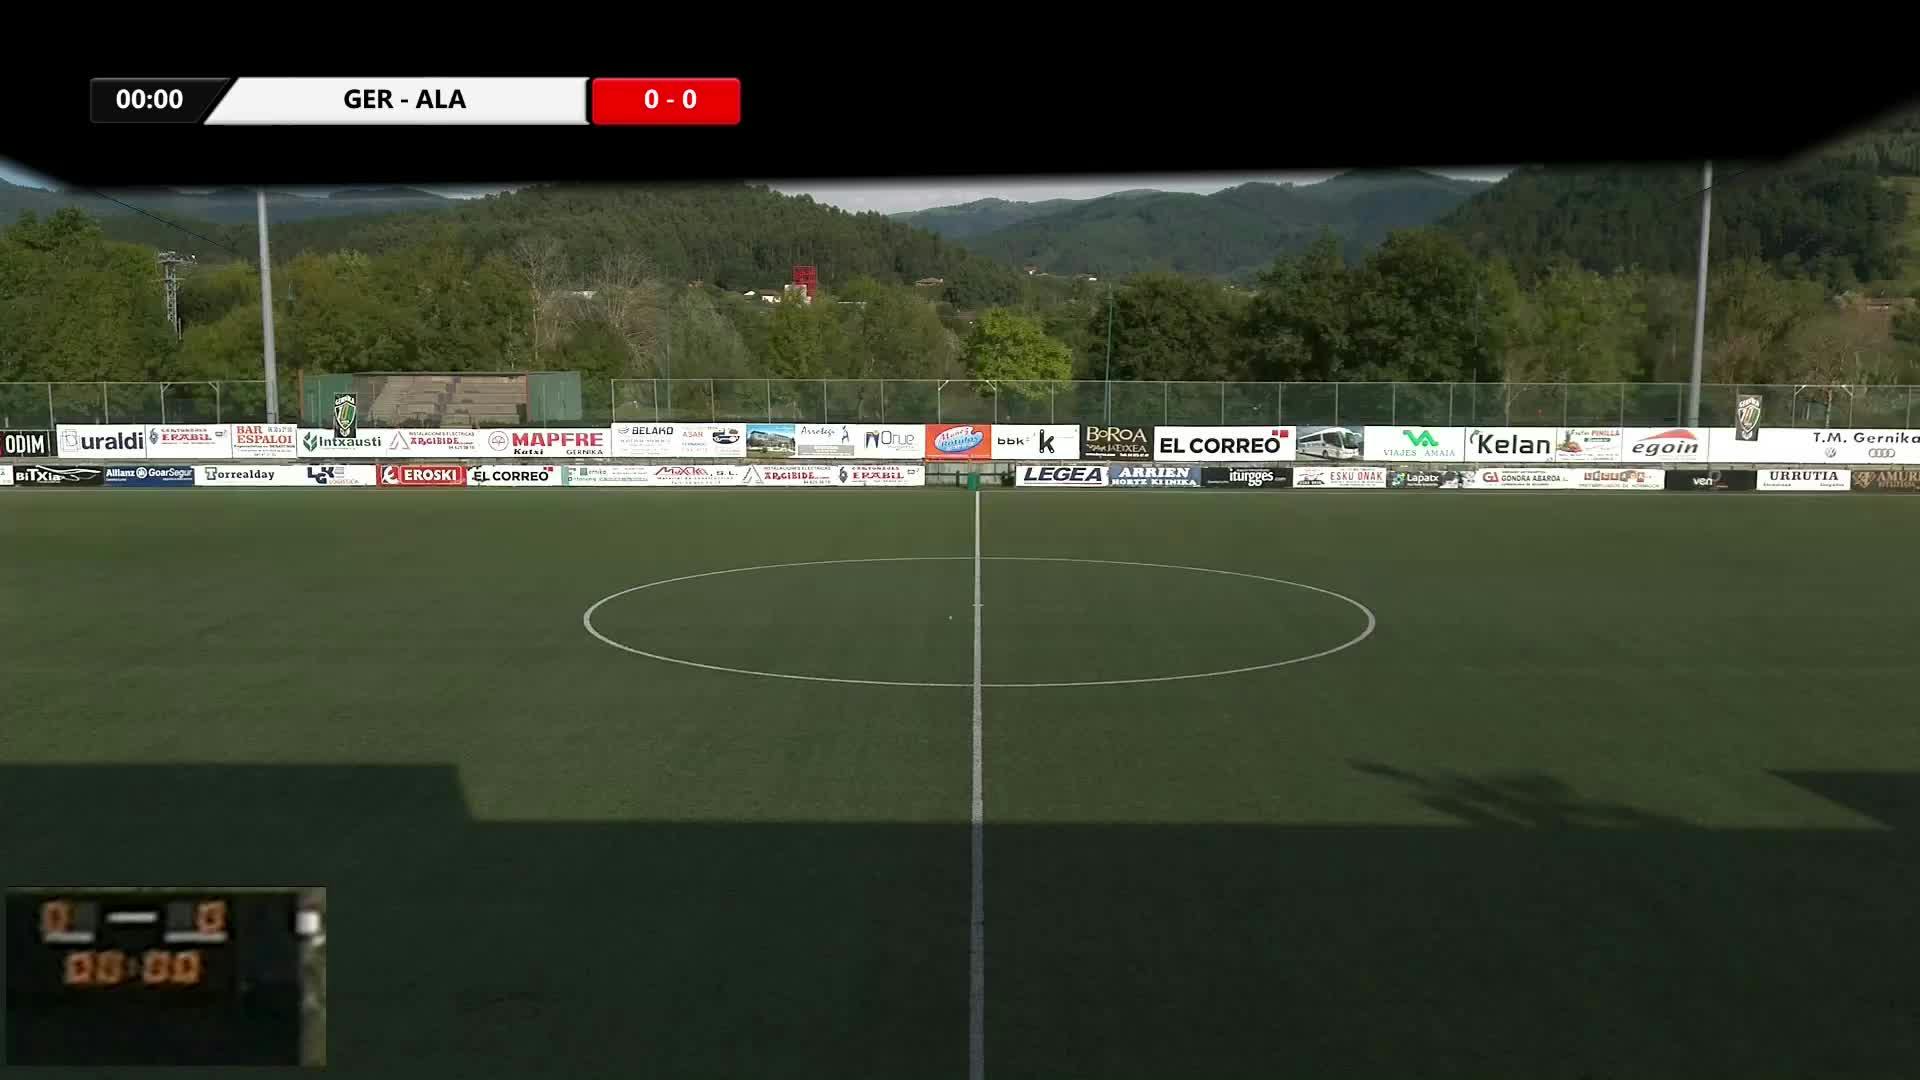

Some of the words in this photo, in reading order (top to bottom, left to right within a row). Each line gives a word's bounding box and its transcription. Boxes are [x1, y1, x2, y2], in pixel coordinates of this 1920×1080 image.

[237, 426, 263, 434] BAR
[632, 426, 674, 435] BELAKO
[82, 432, 143, 450] uraldi
[237, 435, 293, 444] ESPALOI
[320, 436, 381, 447] Intxausti
[512, 432, 603, 447] MAPFRE
[997, 437, 1025, 446] bbk
[1813, 432, 1847, 443] T.M.
[1854, 432, 1920, 443] Gernika
[6, 434, 45, 454] ODIM
[1160, 437, 1186, 454] EL
[1189, 437, 1281, 454] CORREO
[1478, 434, 1551, 454] Kelan
[1632, 440, 1699, 457] egoin
[1384, 449, 1417, 457] VIAJES
[1425, 449, 1456, 457] AMAIA
[106, 468, 135, 477] Allianz
[205, 467, 275, 480] Torrealday
[404, 469, 457, 481] EROSKI
[474, 471, 490, 482] EL
[492, 471, 549, 482] CORREO
[1023, 467, 1103, 482] LEGEA
[1119, 467, 1191, 478] ARRIEN
[1330, 472, 1354, 481] ESKU
[1357, 472, 1383, 481] ONAK
[1770, 471, 1839, 481] URRUTIA
